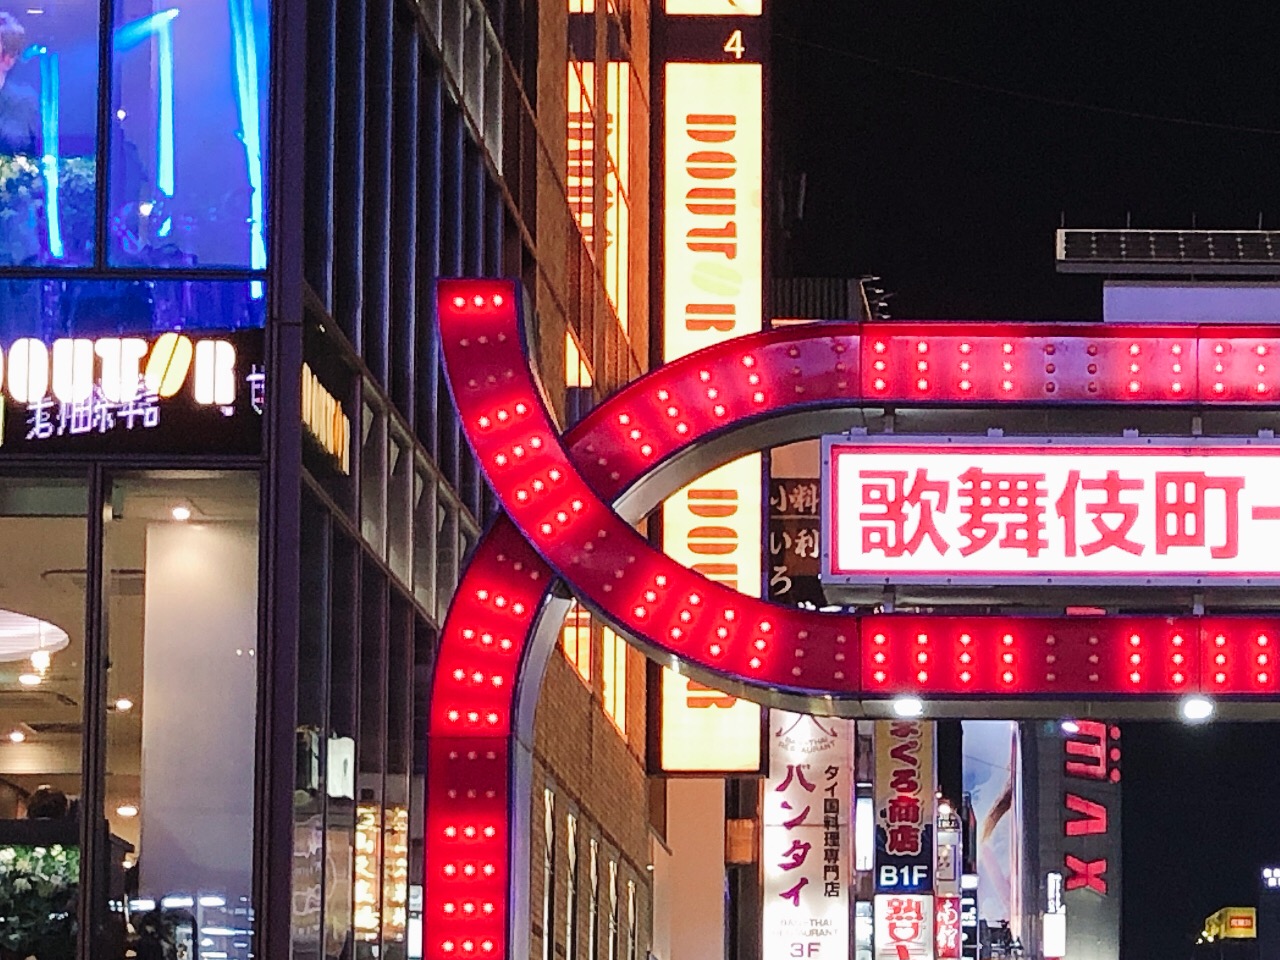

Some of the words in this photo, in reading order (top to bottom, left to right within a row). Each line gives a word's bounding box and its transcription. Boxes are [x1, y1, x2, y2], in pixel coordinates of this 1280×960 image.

[724, 29, 745, 59] 4
[686, 114, 742, 331] DOUTOR
[775, 763, 817, 908] バンタイ
[823, 764, 841, 898] タイ国料理専門店
[880, 865, 929, 886] B1F
[790, 942, 821, 958] 3F
